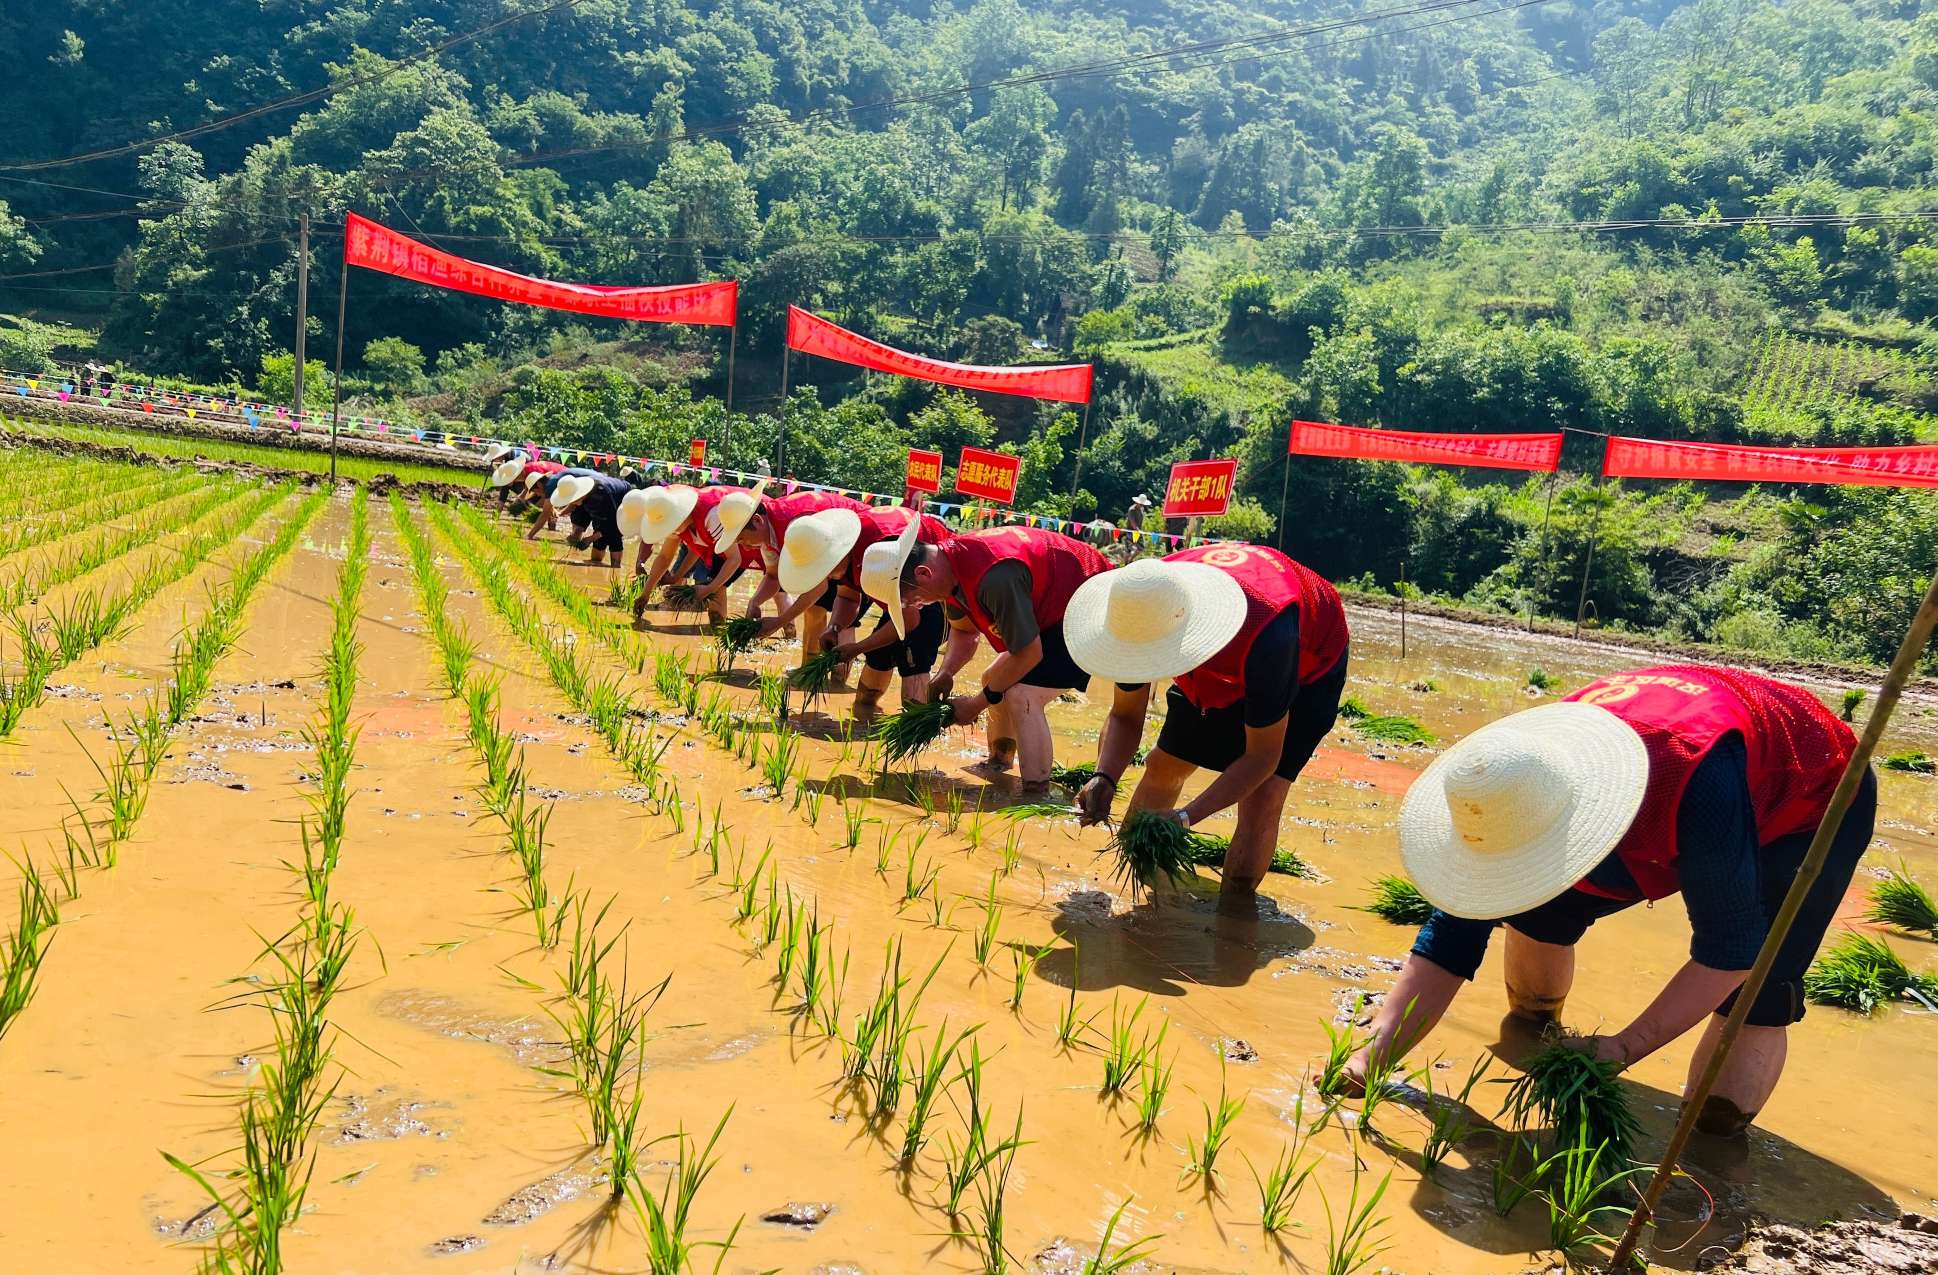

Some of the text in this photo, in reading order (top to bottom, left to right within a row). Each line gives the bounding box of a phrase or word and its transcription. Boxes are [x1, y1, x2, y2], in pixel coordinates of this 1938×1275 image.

[960, 458, 1014, 491] 志愿服务代表队
[1850, 452, 1938, 477] 助力乡村
[1168, 474, 1229, 503] 机关干部1队
